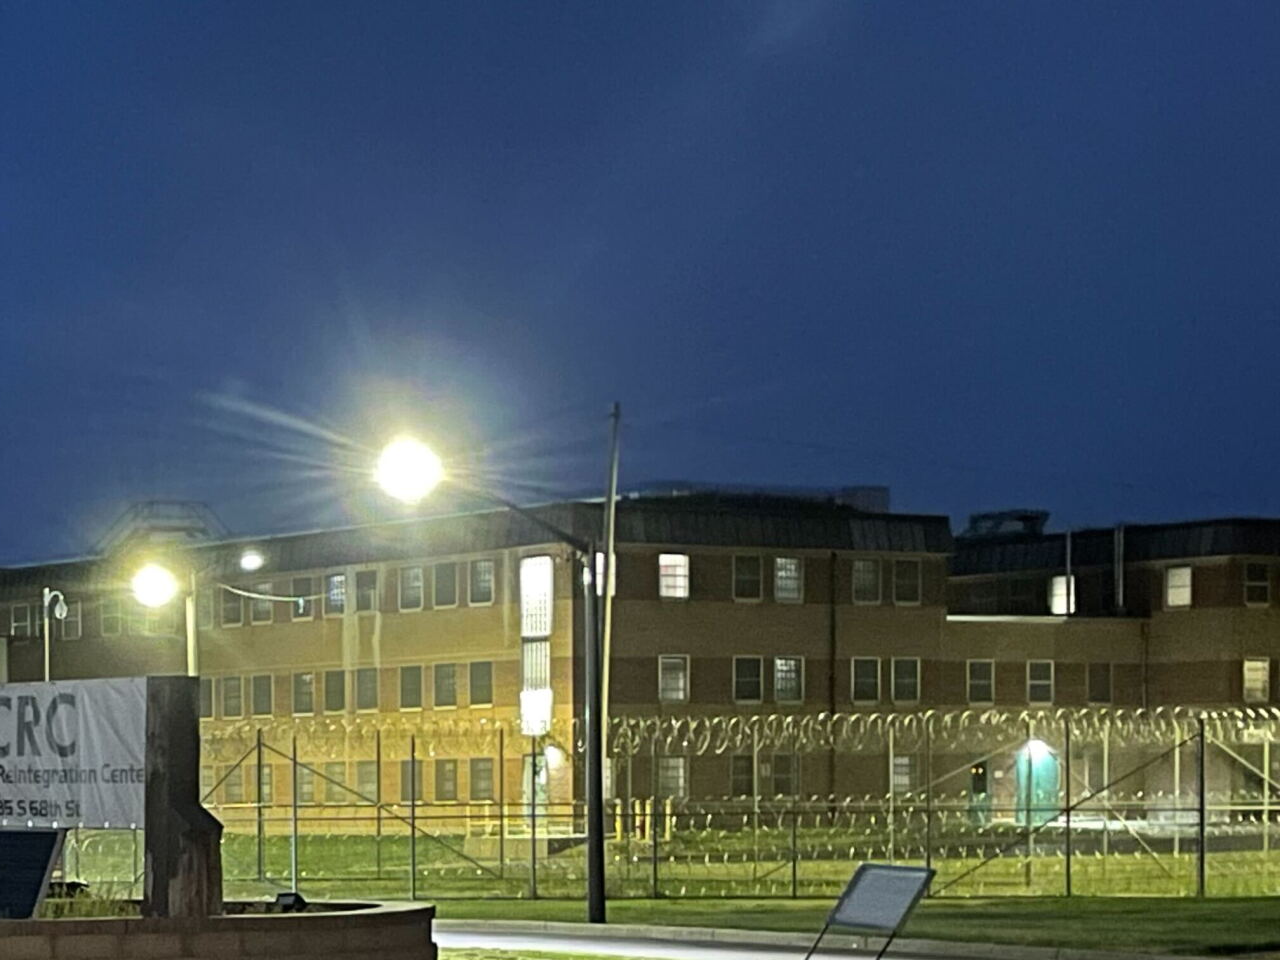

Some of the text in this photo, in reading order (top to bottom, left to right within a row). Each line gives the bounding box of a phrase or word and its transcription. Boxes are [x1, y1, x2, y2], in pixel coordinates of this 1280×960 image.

[102, 763, 145, 784] Cente
[17, 799, 27, 817] S
[29, 799, 62, 817] 68th
